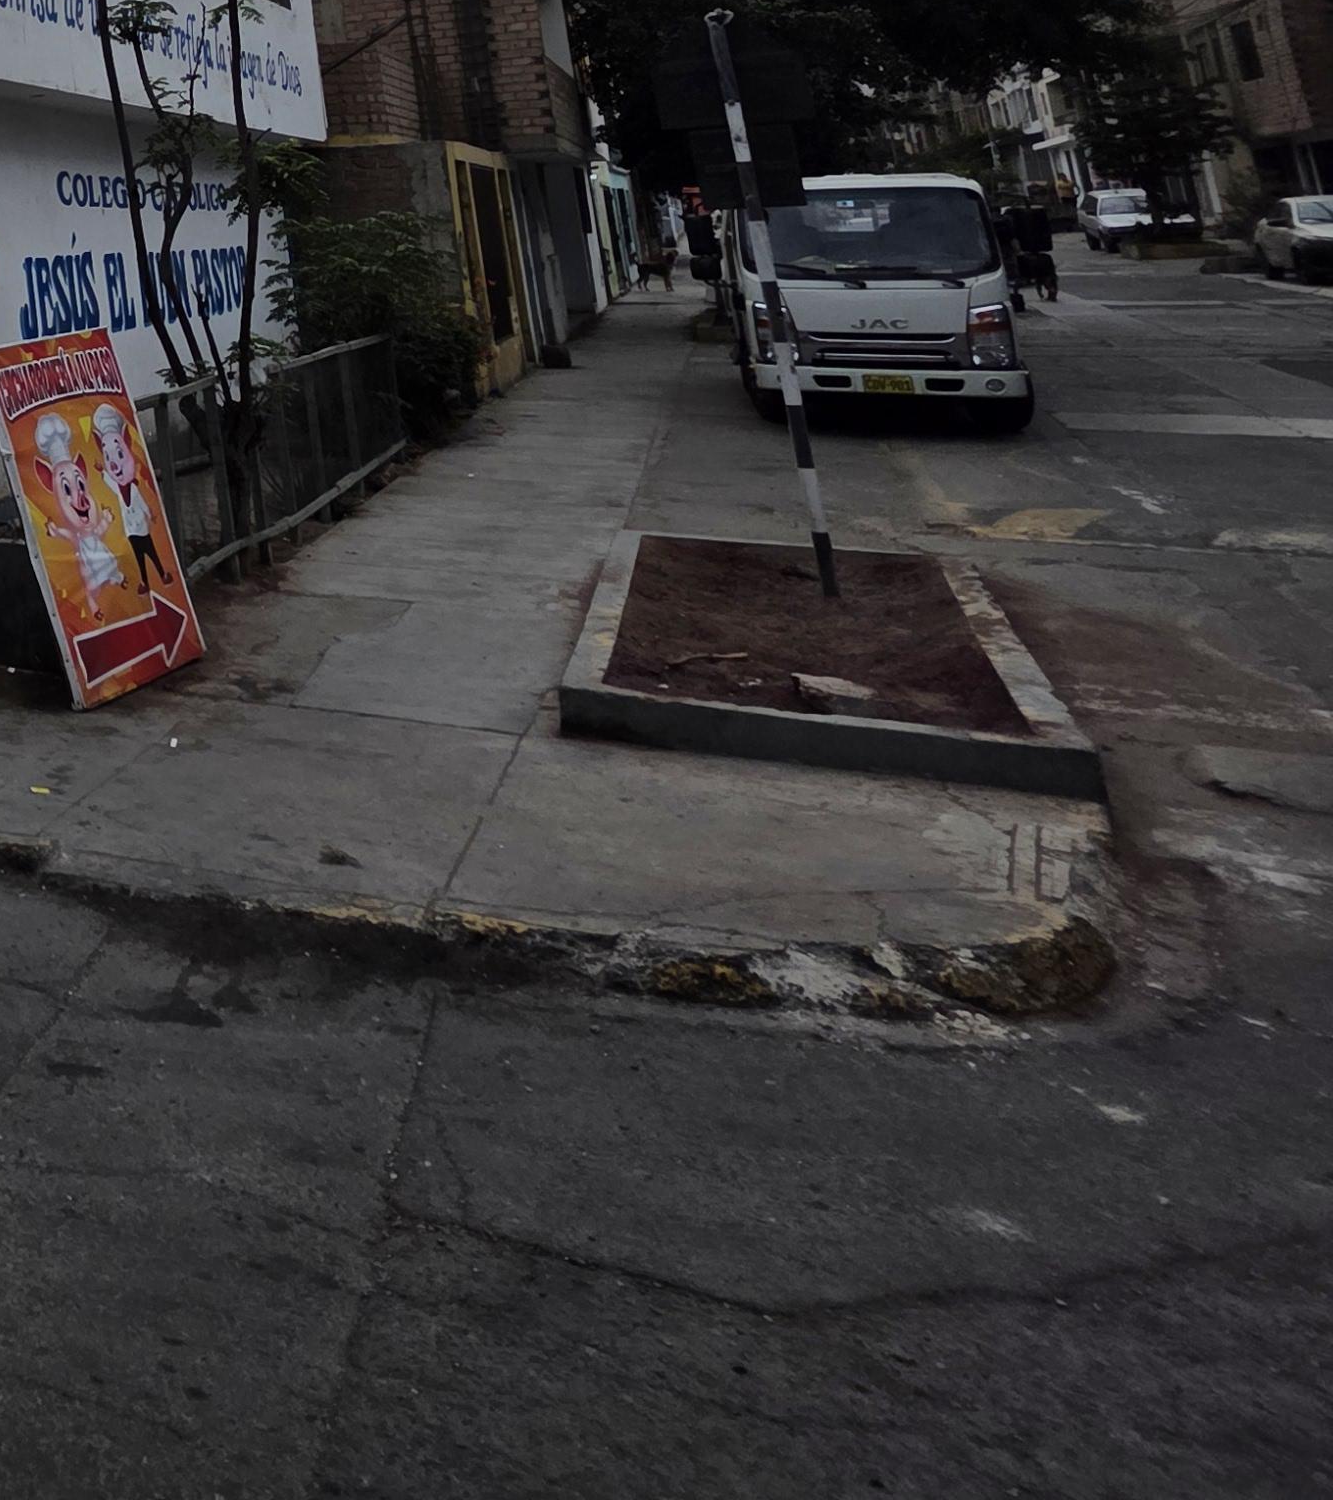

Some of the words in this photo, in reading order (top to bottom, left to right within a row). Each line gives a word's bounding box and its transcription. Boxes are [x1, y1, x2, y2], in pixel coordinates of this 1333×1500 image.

[227, 35, 265, 100] iagen
[277, 50, 302, 97] Dios
[55, 170, 147, 210] COLEGO
[150, 181, 228, 212] COLICO
[19, 231, 100, 341] JESÚS
[103, 252, 137, 334] EL
[851, 318, 910, 330] JAC
